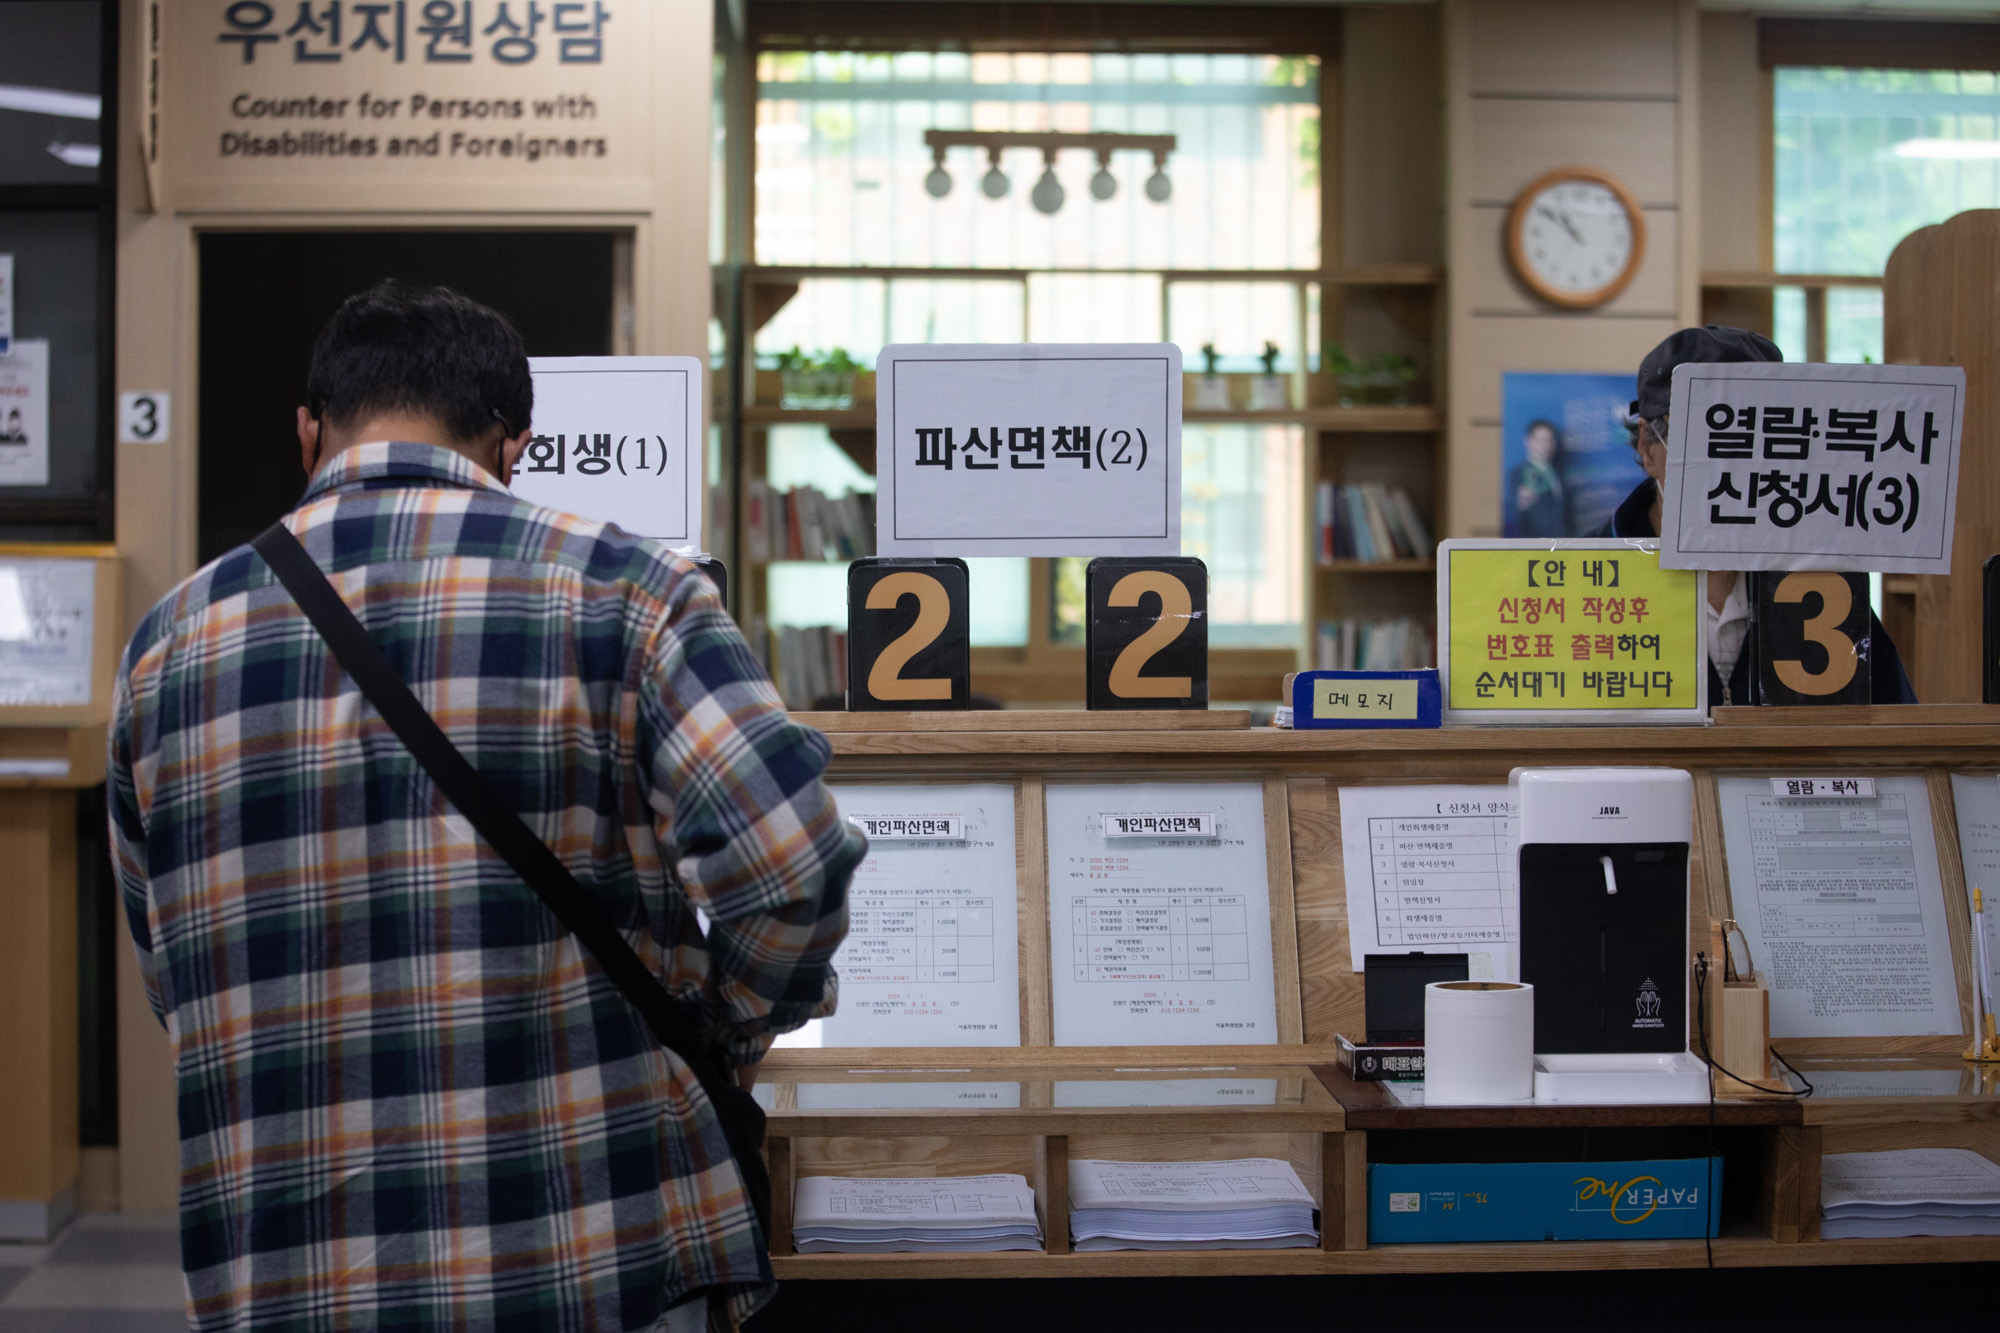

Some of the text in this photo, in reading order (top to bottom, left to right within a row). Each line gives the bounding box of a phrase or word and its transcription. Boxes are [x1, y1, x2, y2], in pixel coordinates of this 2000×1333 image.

[218, 0, 610, 64] 우선지원상담
[232, 93, 596, 118] Counter for Persons with
[220, 132, 606, 160] Disabilities and Foreigners
[130, 397, 158, 439] 3
[1705, 403, 1939, 464] 열람·복사
[511, 434, 667, 476] 회생(1)
[915, 425, 1149, 471] 파산면책(2)
[1707, 470, 1919, 533] 신청서(3)
[1498, 597, 1650, 624] 신청서 작성후
[865, 572, 952, 701] 2
[1108, 570, 1192, 699] 2
[1487, 634, 1660, 660] 번호표 출력하여
[1772, 571, 1857, 697] 3
[1475, 672, 1673, 698] 순서대기 바랍니다
[1786, 780, 1859, 795] 열람 복사
[1449, 803, 1481, 814] 신청서
[1600, 807, 1620, 815] JAVA
[864, 820, 950, 835] 개인파산면책
[1115, 817, 1201, 832] 개인파산면책
[1398, 823, 1449, 832] 개인회생제증명
[1402, 878, 1424, 886] 위임장
[1404, 896, 1441, 904] 면책신청서
[1405, 914, 1443, 922] 회생제증명
[1383, 1057, 1425, 1071] 매표인
[1476, 1193, 1488, 1203] 75
[1572, 1176, 1697, 1224] PAPER One
